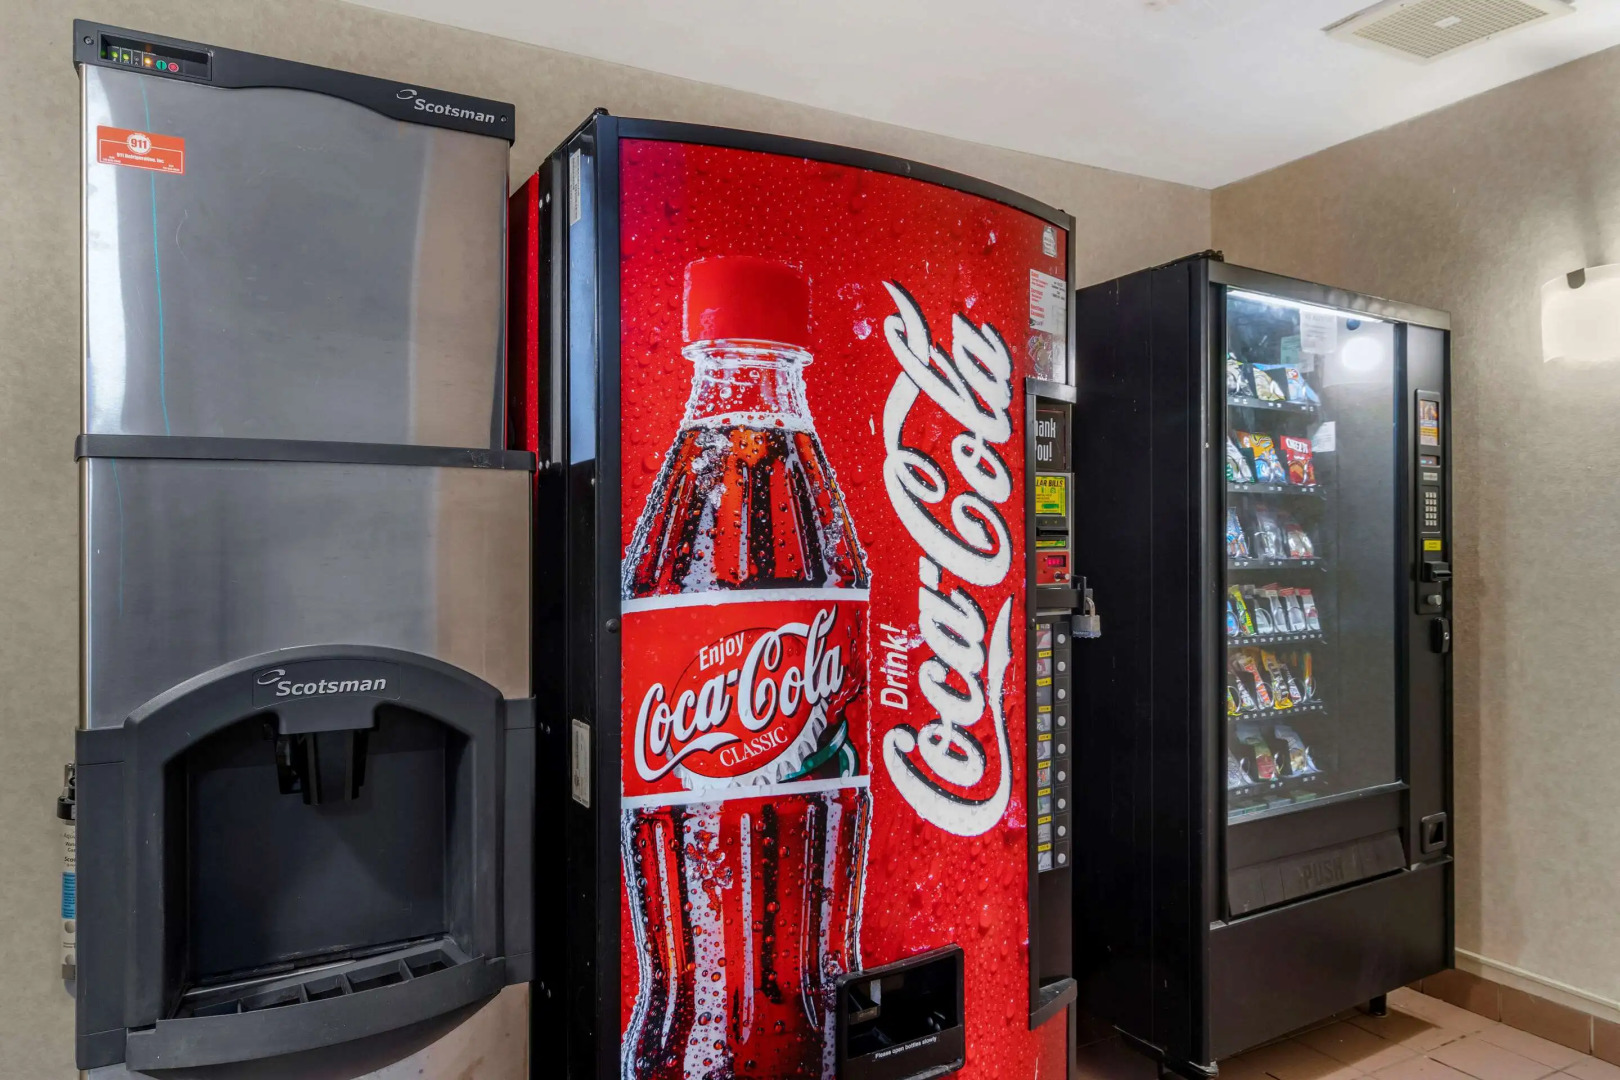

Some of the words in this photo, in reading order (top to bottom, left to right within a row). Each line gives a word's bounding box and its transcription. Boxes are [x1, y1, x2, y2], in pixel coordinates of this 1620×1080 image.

[413, 98, 495, 124] Scotsman
[130, 138, 148, 150] 911
[1034, 441, 1053, 462] ou!
[882, 279, 1014, 837] Coca-Cola
[699, 632, 745, 672] Enjoy
[880, 622, 908, 711] Drink!
[275, 679, 387, 697] Scotsman
[634, 603, 845, 783] Coca-Cola
[719, 726, 788, 767] CLASSIC
[1302, 855, 1345, 889] PUSH
[874, 1050, 892, 1060] Please
[892, 1046, 905, 1055] open
[904, 1041, 922, 1051] bottles
